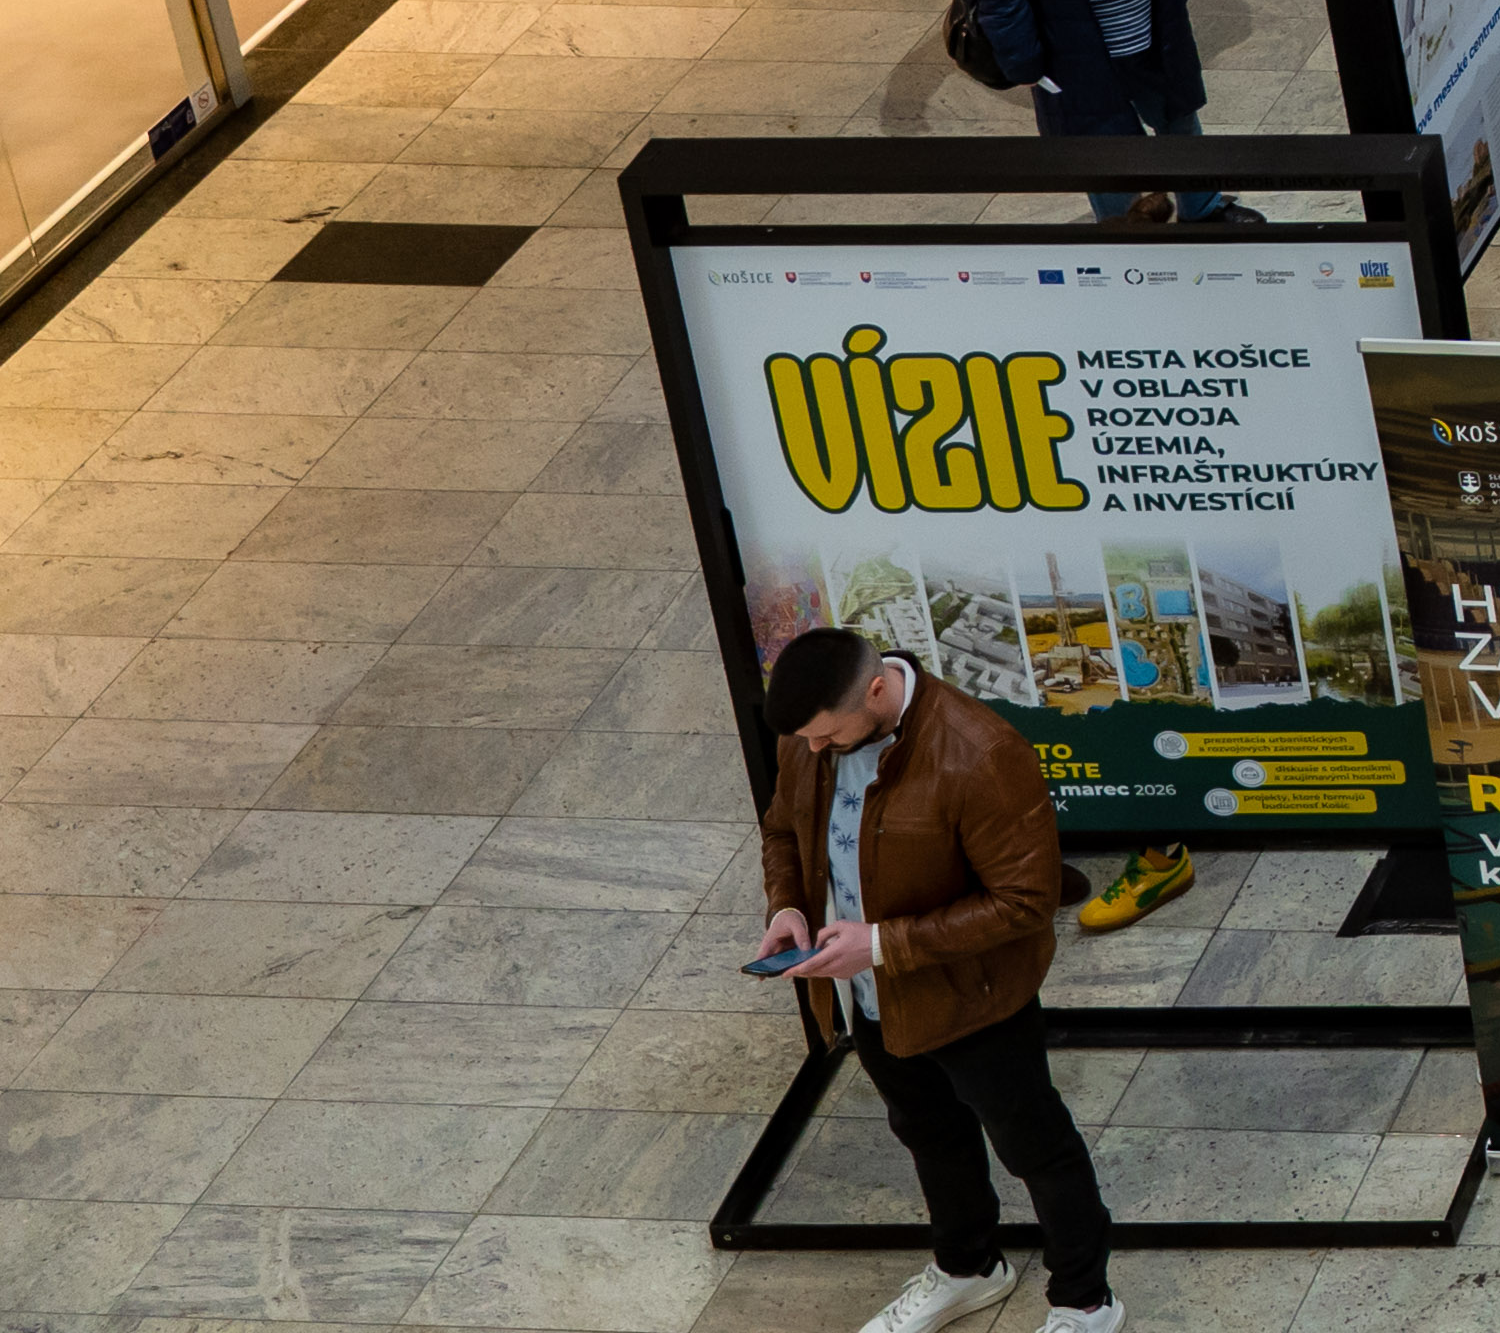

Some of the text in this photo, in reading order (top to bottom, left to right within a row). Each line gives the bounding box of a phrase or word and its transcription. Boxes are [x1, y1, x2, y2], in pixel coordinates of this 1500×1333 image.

[723, 270, 774, 284] KOŠICE
[1076, 343, 1311, 370] MESTA KOŠICE
[1080, 378, 1249, 399] V OBLASTI
[764, 324, 1090, 514] VÍZIE
[1088, 407, 1240, 428] ROZVOJA
[1092, 431, 1226, 459] ÚZEMIA,
[1097, 456, 1379, 485] INFRAŠTRUKTÚRY
[1103, 484, 1296, 512] A INVESTÍCIÍ
[1060, 785, 1176, 796] marec 2026
